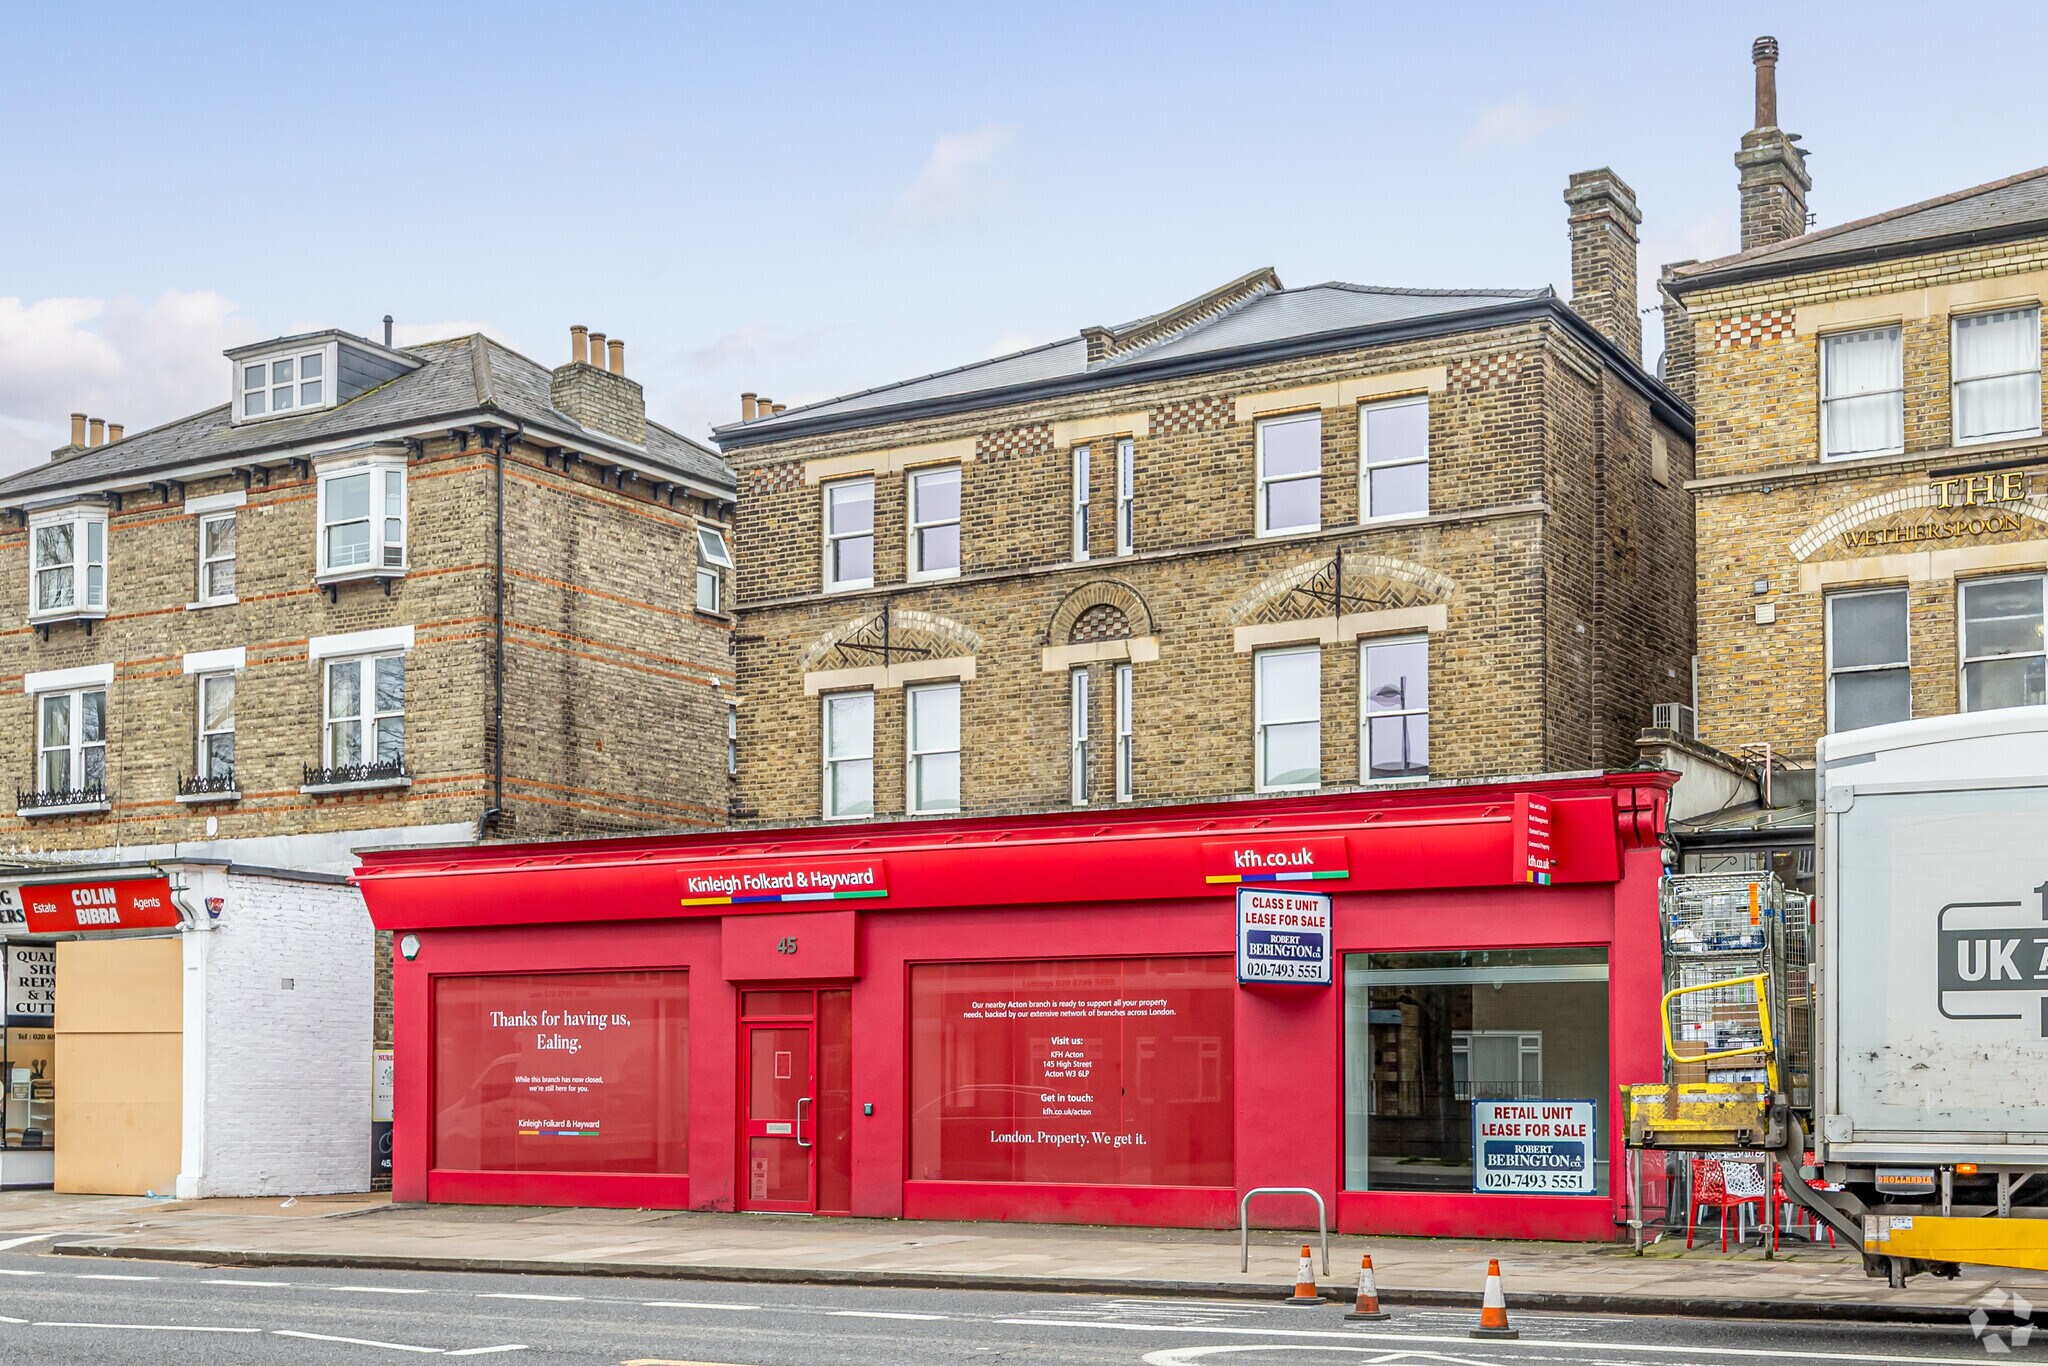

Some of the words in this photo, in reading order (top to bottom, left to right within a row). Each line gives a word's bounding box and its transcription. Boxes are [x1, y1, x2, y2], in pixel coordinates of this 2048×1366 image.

[1929, 471, 2026, 509] THE
[1841, 514, 2023, 549] WETHERSPOON
[1234, 847, 1314, 868] kfh.co.uk
[1528, 854, 1550, 870] kfh.co.uk
[688, 874, 741, 894] Kinleigh
[743, 872, 794, 890] Folkard
[796, 872, 809, 887] &
[810, 867, 874, 890] Hayward
[32, 902, 57, 914] Estate
[71, 887, 117, 906] COLIN
[133, 897, 161, 911] Agents
[1252, 896, 1284, 909] CLASS
[1286, 899, 1293, 910] E
[1295, 900, 1319, 912] UNIT
[0, 909, 26, 924] ERS
[75, 906, 120, 925] BIBRA
[1245, 912, 1277, 925] LEASE
[1279, 914, 1299, 926] FOR
[1300, 916, 1326, 928] SALE
[777, 937, 798, 955] 45
[1270, 934, 1301, 944] ROBERT
[1249, 942, 1313, 958] BEBINGTON
[1957, 938, 2023, 982] UK
[1247, 962, 1295, 978] 020-7493
[1297, 965, 1322, 979] 5551
[1022, 980, 1054, 989] Lettings
[1055, 979, 1071, 988] 020
[27, 989, 40, 1001] &
[985, 1001, 1007, 1009] nearby
[1028, 1000, 1051, 1008] branch
[1058, 1000, 1077, 1008] ready
[1113, 999, 1122, 1007] all
[1122, 1000, 1137, 1008] your
[1138, 999, 1168, 1008] property
[963, 1010, 984, 1019] needs,
[1008, 1010, 1017, 1019] by
[1029, 1009, 1060, 1018] extensive
[1060, 1009, 1087, 1017] network
[1087, 1008, 1096, 1017] of
[1096, 1008, 1126, 1017] branches
[1126, 1009, 1148, 1017] across
[1149, 1007, 1177, 1016] London.
[490, 1011, 538, 1027] Thanks
[541, 1010, 561, 1026] for
[563, 1010, 608, 1031] having
[611, 1013, 631, 1028] us,
[536, 1033, 582, 1054] Ealing.
[1051, 1036, 1070, 1046] Visit
[1071, 1037, 1084, 1046] us:
[1050, 1050, 1064, 1059] KFH
[1065, 1050, 1084, 1059] Acton
[1042, 1060, 1055, 1068] 145
[1056, 1060, 1072, 1069] High
[1073, 1060, 1093, 1068] Street
[584, 1076, 604, 1084] closed,
[1045, 1070, 1064, 1078] Acton
[1065, 1070, 1077, 1078] W3
[1078, 1070, 1090, 1078] 6LP
[1040, 1093, 1056, 1103] Get
[1057, 1093, 1066, 1102] in
[1067, 1093, 1094, 1103] touch:
[1042, 1107, 1092, 1116] kfh.co.uk/acton
[1494, 1107, 1538, 1120] RETAIL
[1542, 1107, 1573, 1120] UNIT
[518, 1119, 542, 1129] Kinleigh
[543, 1119, 565, 1128] Folkard
[566, 1120, 572, 1128] &
[572, 1120, 600, 1129] Hayward
[1482, 1123, 1521, 1137] LEASE
[1525, 1124, 1550, 1137] FOR
[1554, 1124, 1587, 1137] SALE
[990, 1130, 1035, 1143] London.
[1037, 1131, 1090, 1147] Property.
[1091, 1131, 1111, 1145] We
[1113, 1133, 1132, 1148] get
[1135, 1132, 1148, 1145] it.
[1514, 1145, 1553, 1154] ROBERT
[1487, 1154, 1570, 1168] BEBINGTON
[1485, 1173, 1547, 1189] 020-7493
[1551, 1175, 1584, 1189] 5551
[1877, 1176, 1932, 1184] DHOLLANDIA
